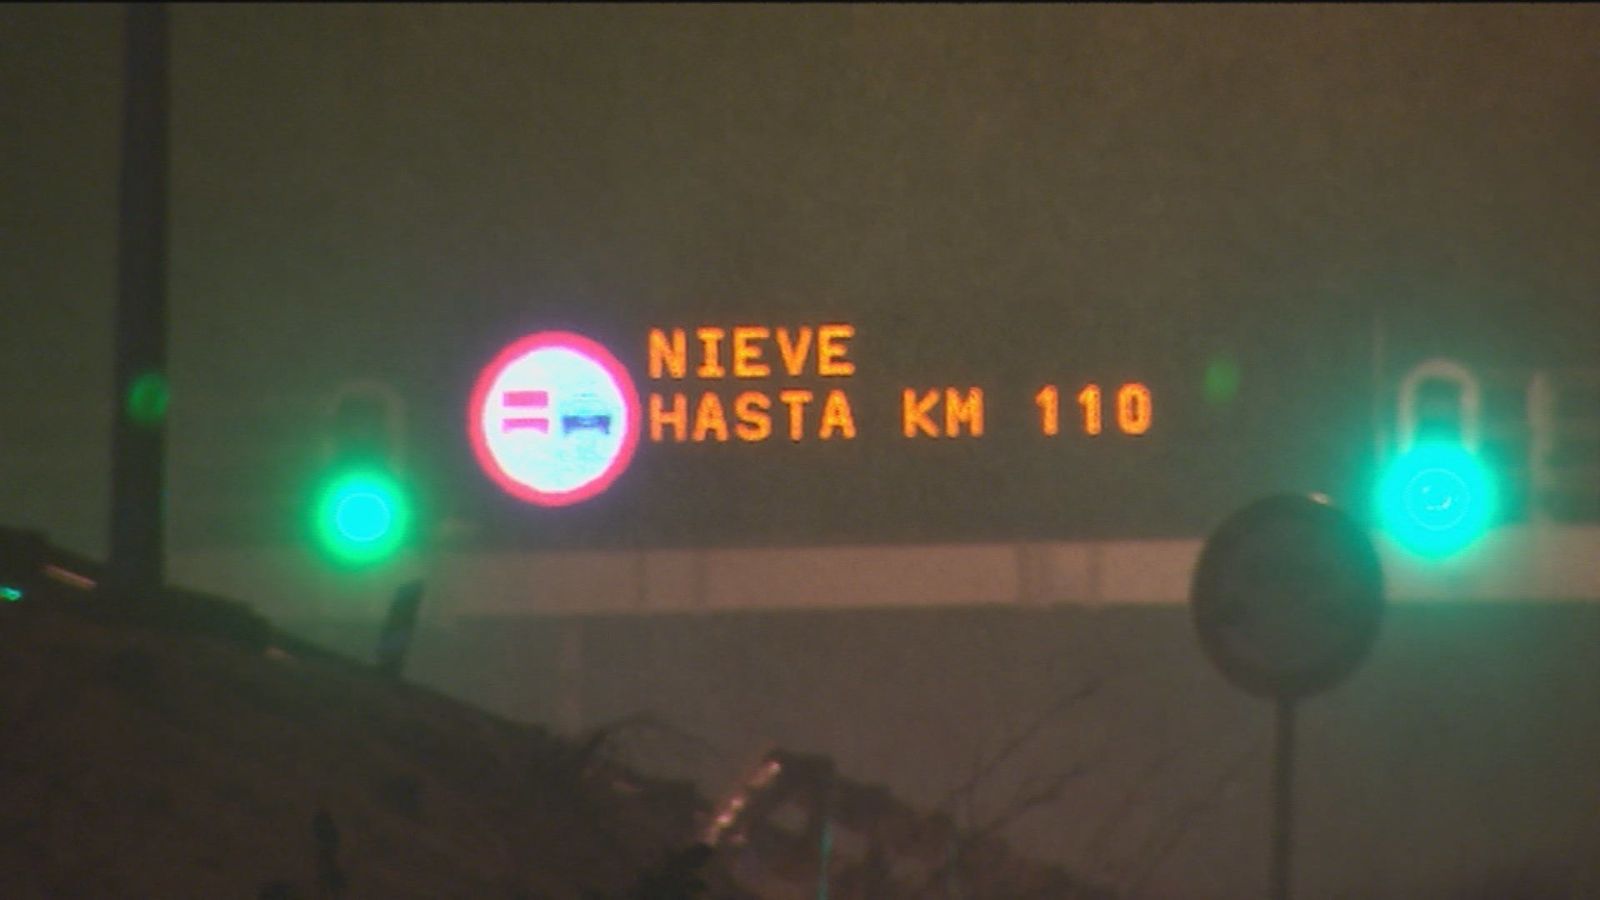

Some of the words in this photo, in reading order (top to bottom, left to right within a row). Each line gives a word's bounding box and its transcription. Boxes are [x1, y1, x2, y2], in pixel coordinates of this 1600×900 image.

[648, 324, 856, 379] NIEVE
[648, 388, 857, 442] HASTA
[902, 386, 985, 438] KM
[1034, 382, 1153, 436] 110
